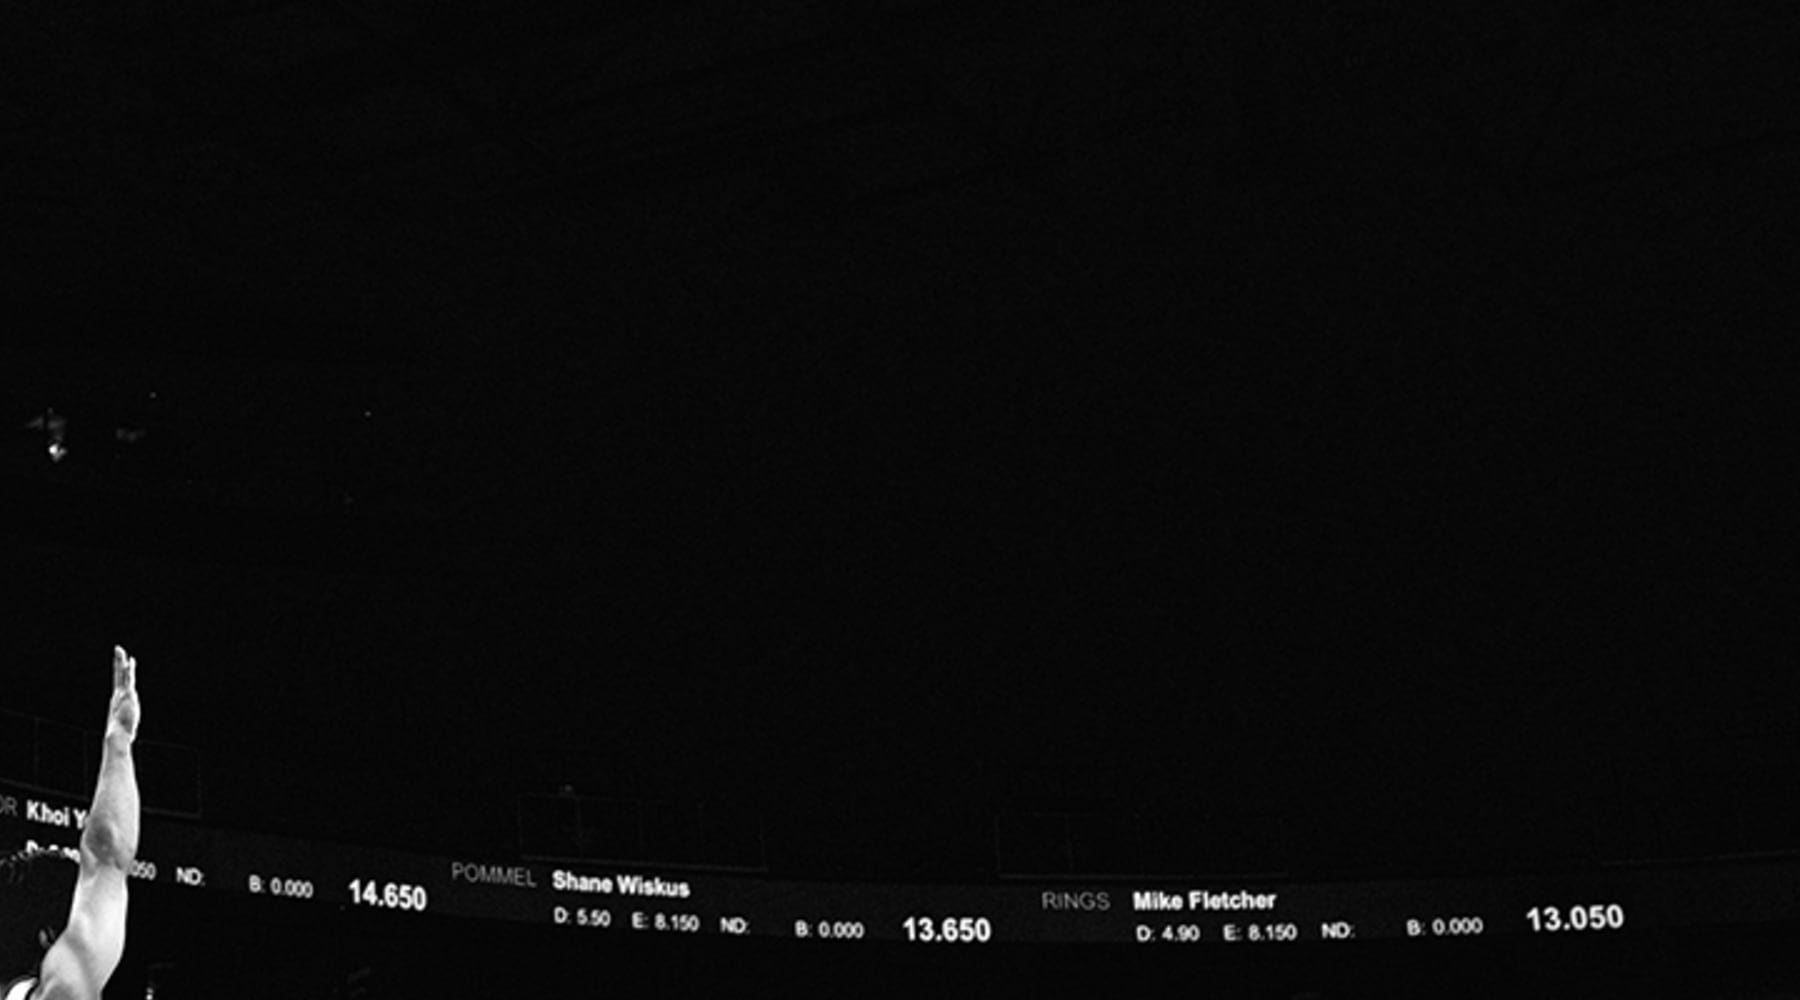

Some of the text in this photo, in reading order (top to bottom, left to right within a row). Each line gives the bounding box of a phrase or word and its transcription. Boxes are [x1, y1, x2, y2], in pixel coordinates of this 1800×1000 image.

[26, 799, 71, 829] Khoi
[175, 866, 314, 899] ND: B: 0.000
[451, 861, 538, 888] POMMEL
[551, 869, 691, 899] Shane Wiskus
[348, 878, 428, 912] 14.650
[1041, 891, 1111, 911] RINGS
[1132, 889, 1278, 911] Mike Fletcher
[553, 905, 866, 940] D: 5.50 E: 8.150 ND: B: 0.000
[902, 916, 992, 943] 13.650
[1135, 916, 1484, 943] D: 4.90 E: 8.150 ND: B: 0.000
[1526, 903, 1625, 932] 13.050
